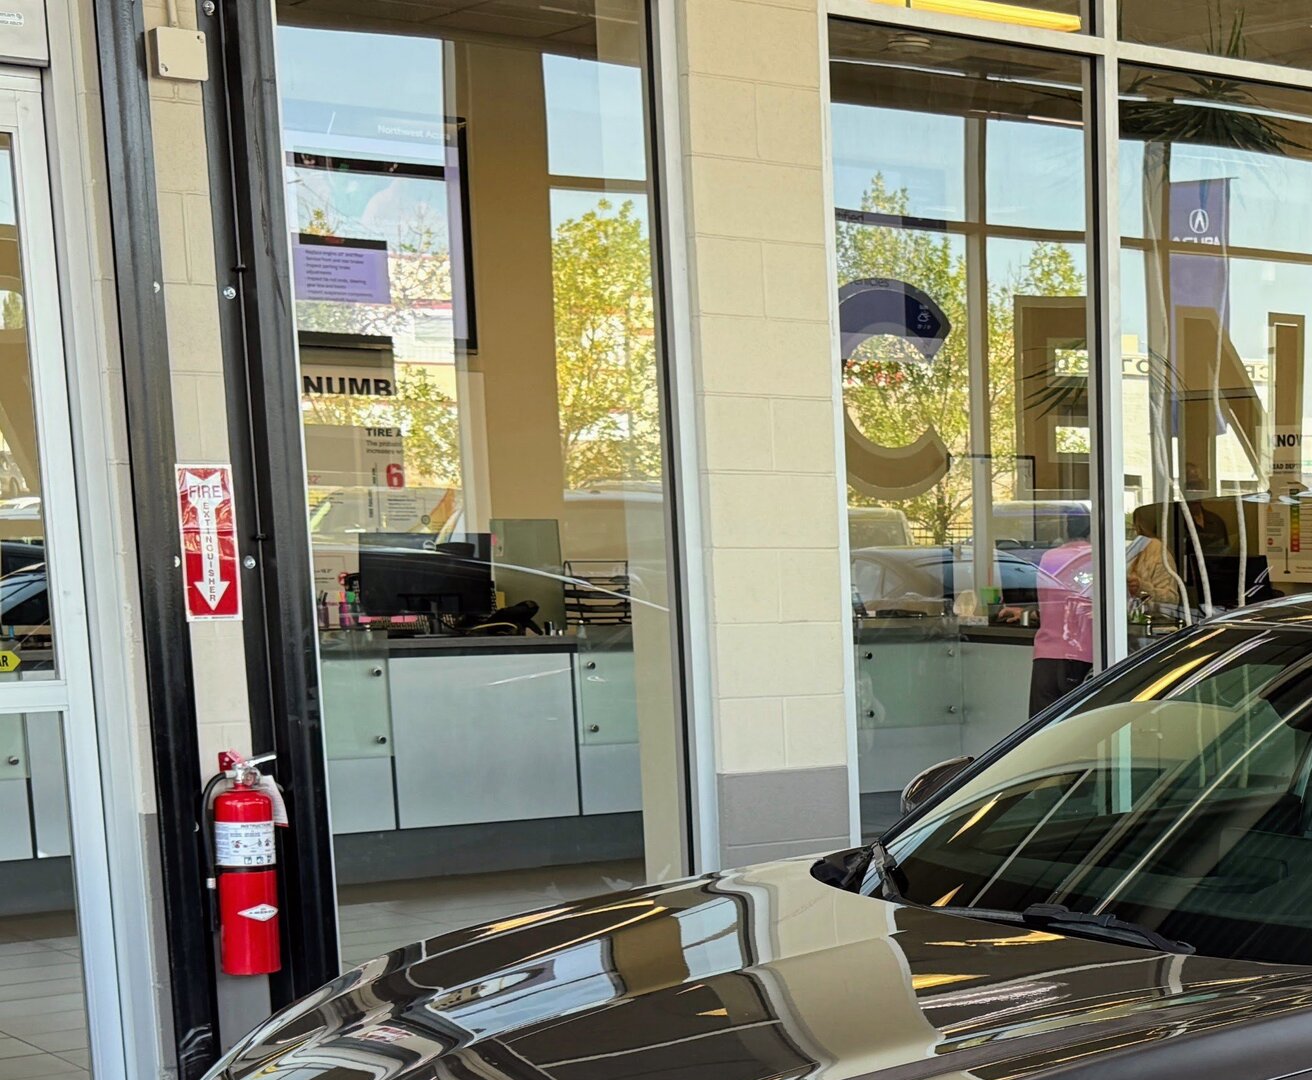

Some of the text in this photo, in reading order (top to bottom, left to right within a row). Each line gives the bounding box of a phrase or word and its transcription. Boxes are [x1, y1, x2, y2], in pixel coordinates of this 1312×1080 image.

[303, 375, 397, 396] NUMB
[366, 428, 393, 437] TIRE
[188, 485, 222, 499] FIRE
[203, 501, 217, 602] EXTINGUISHER
